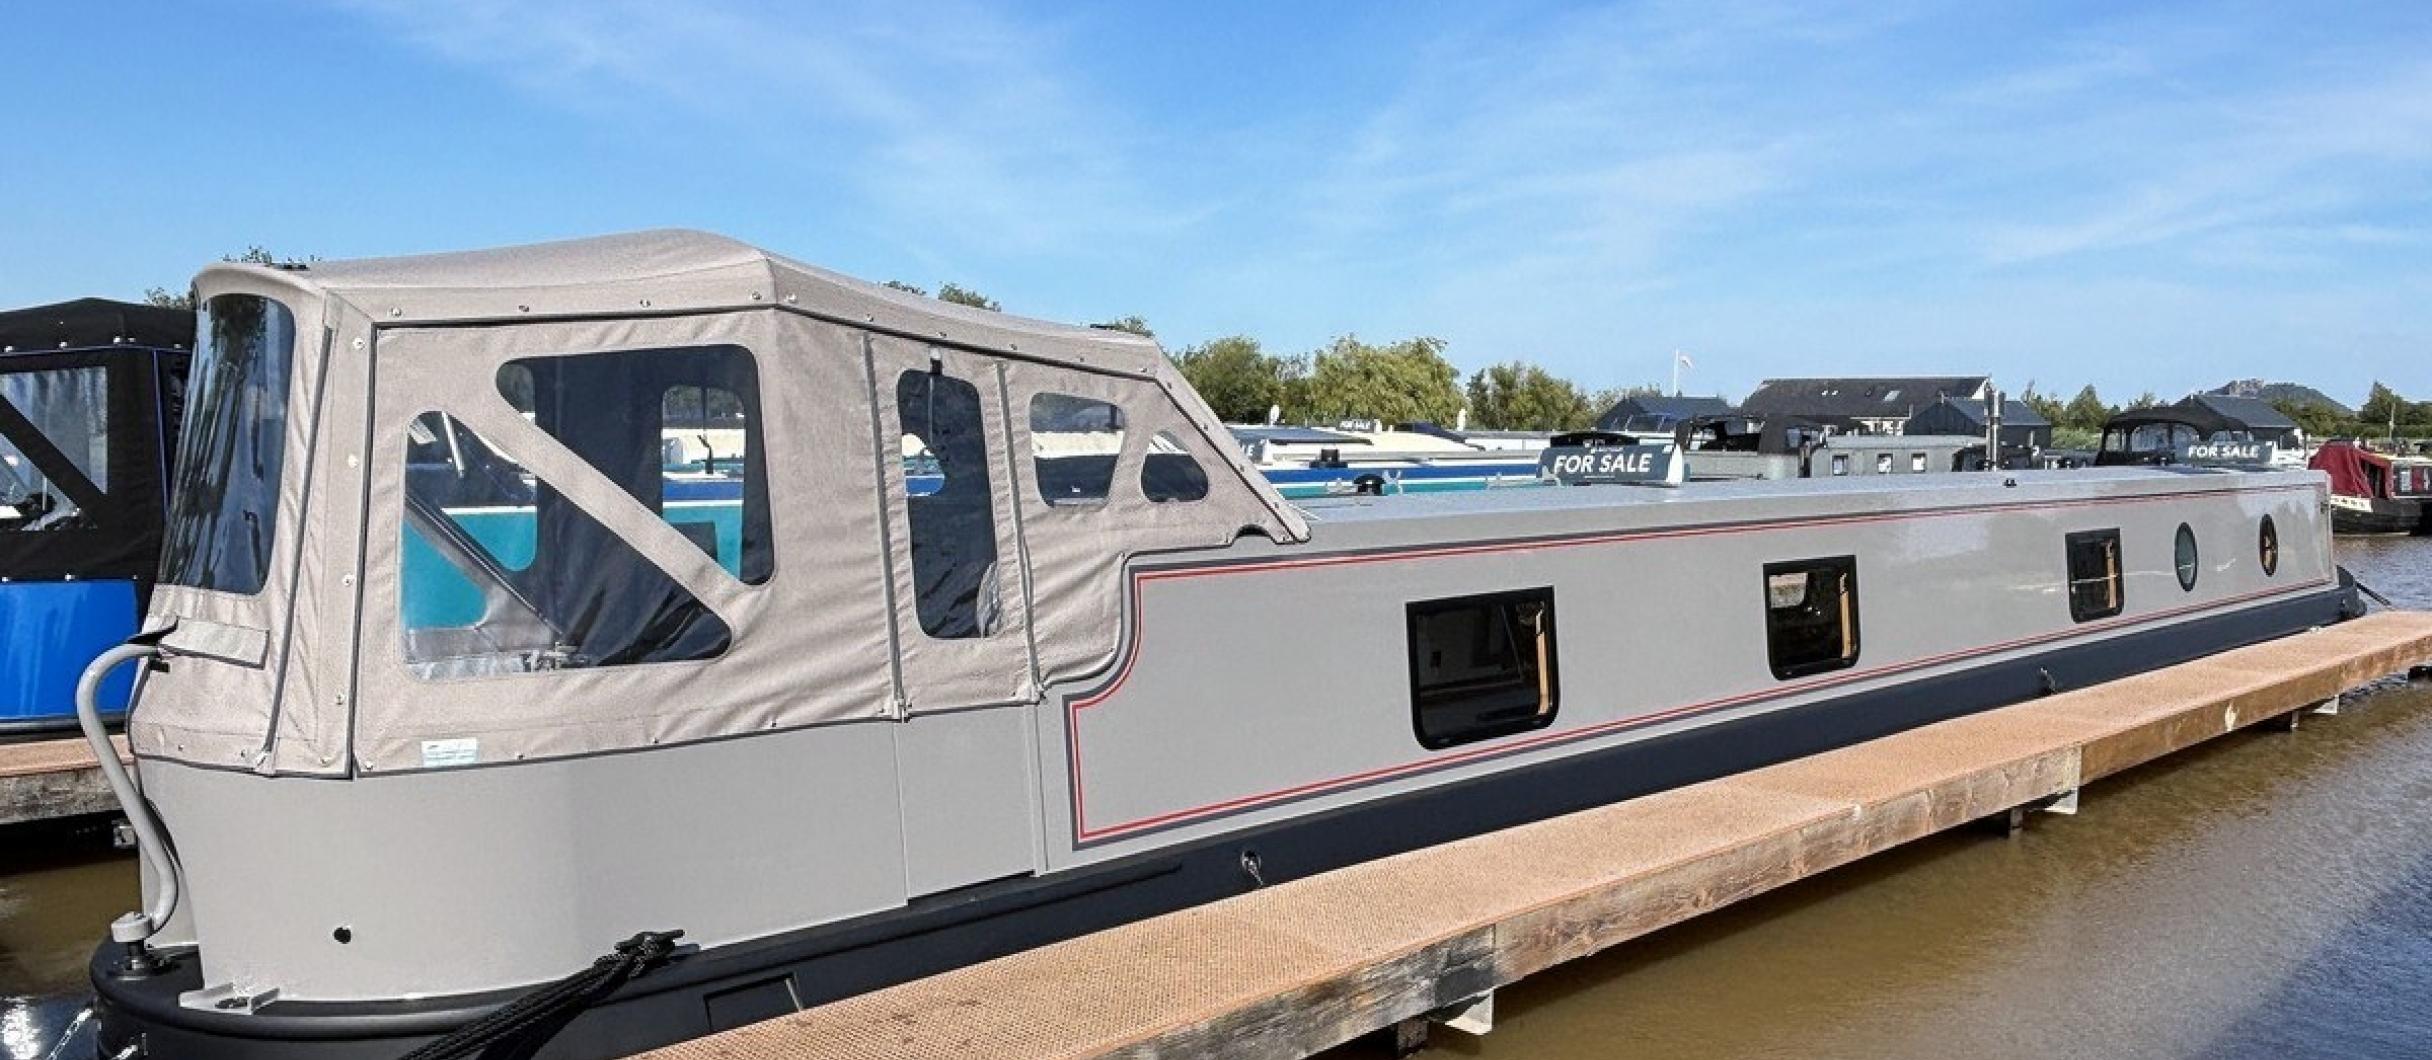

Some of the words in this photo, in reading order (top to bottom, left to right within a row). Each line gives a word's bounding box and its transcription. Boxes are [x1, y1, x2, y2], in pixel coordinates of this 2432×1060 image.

[2188, 445, 2218, 459] FOR
[2221, 444, 2260, 459] SALE
[1553, 455, 1594, 475] FOR
[1598, 453, 1653, 473] SALE
